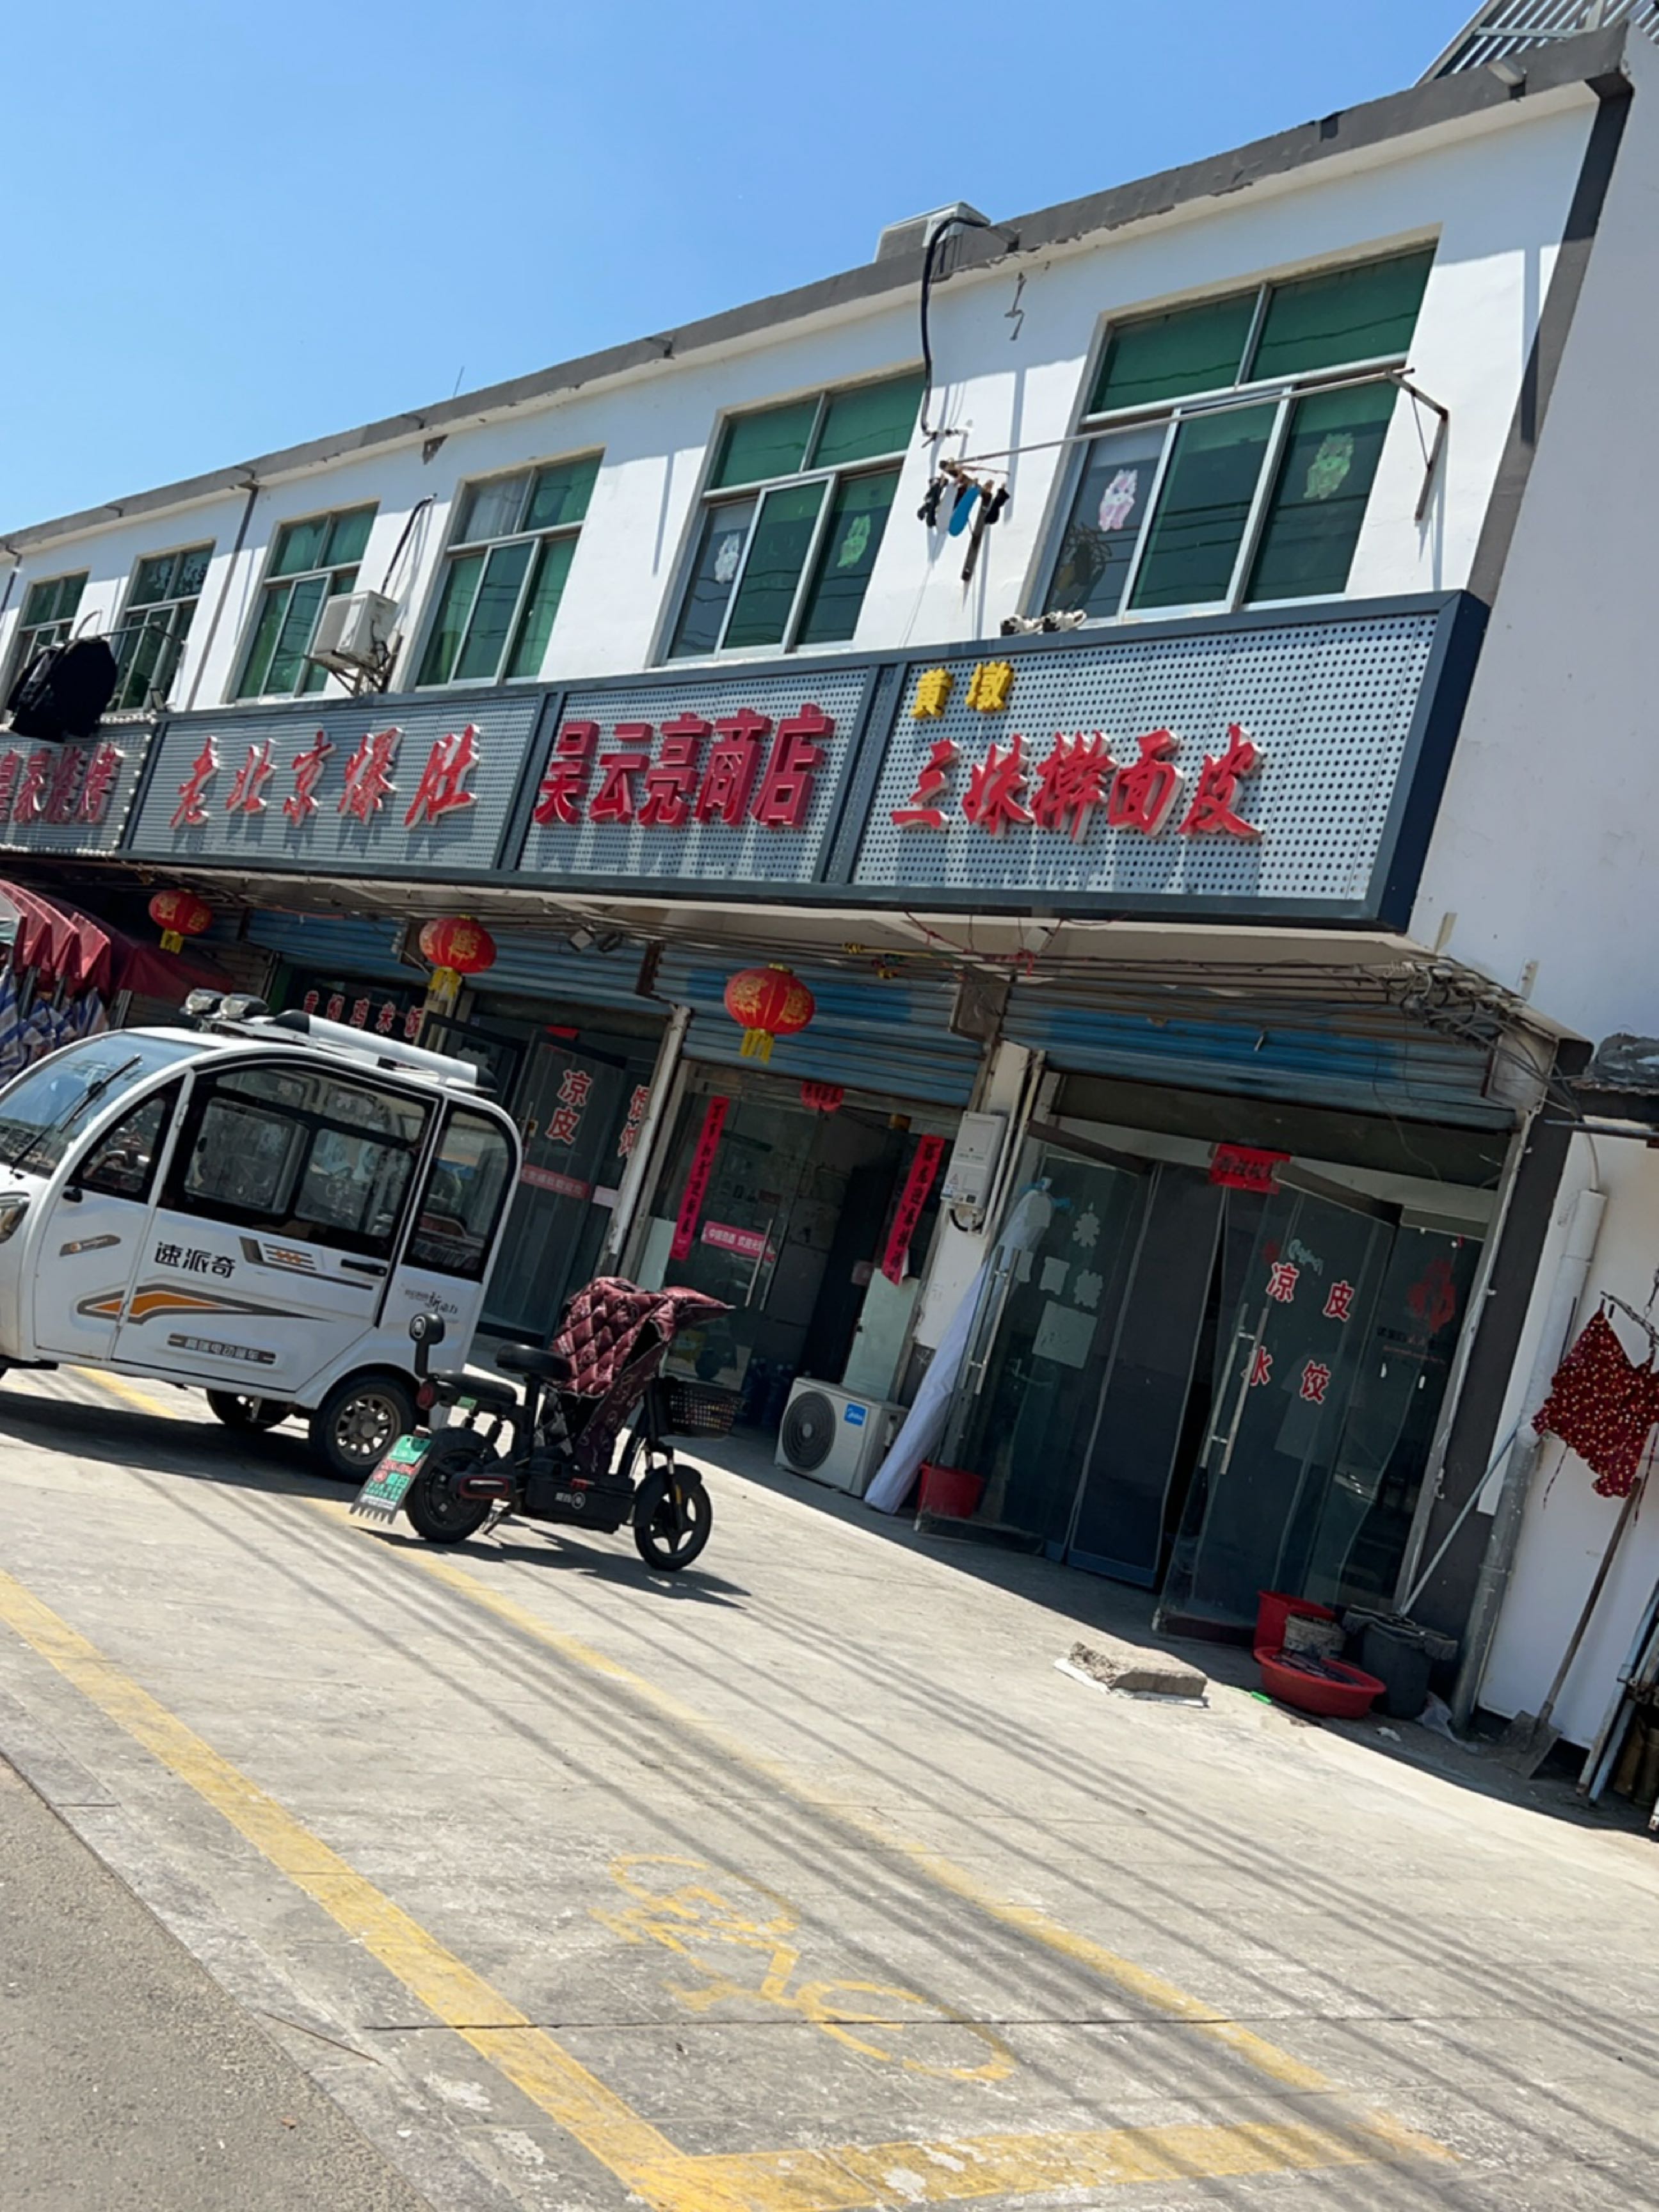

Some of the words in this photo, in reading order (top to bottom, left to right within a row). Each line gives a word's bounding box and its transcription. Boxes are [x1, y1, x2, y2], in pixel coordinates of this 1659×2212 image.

[911, 661, 1015, 719] 黄墩
[170, 724, 480, 829] 老北京爆肚
[534, 703, 835, 830] 吴云亮商店
[545, 1069, 594, 1146] 凉皮
[154, 1241, 236, 1278] 速派奇
[1265, 1261, 1356, 1322] 凉皮
[1240, 1345, 1331, 1405] 水饺
